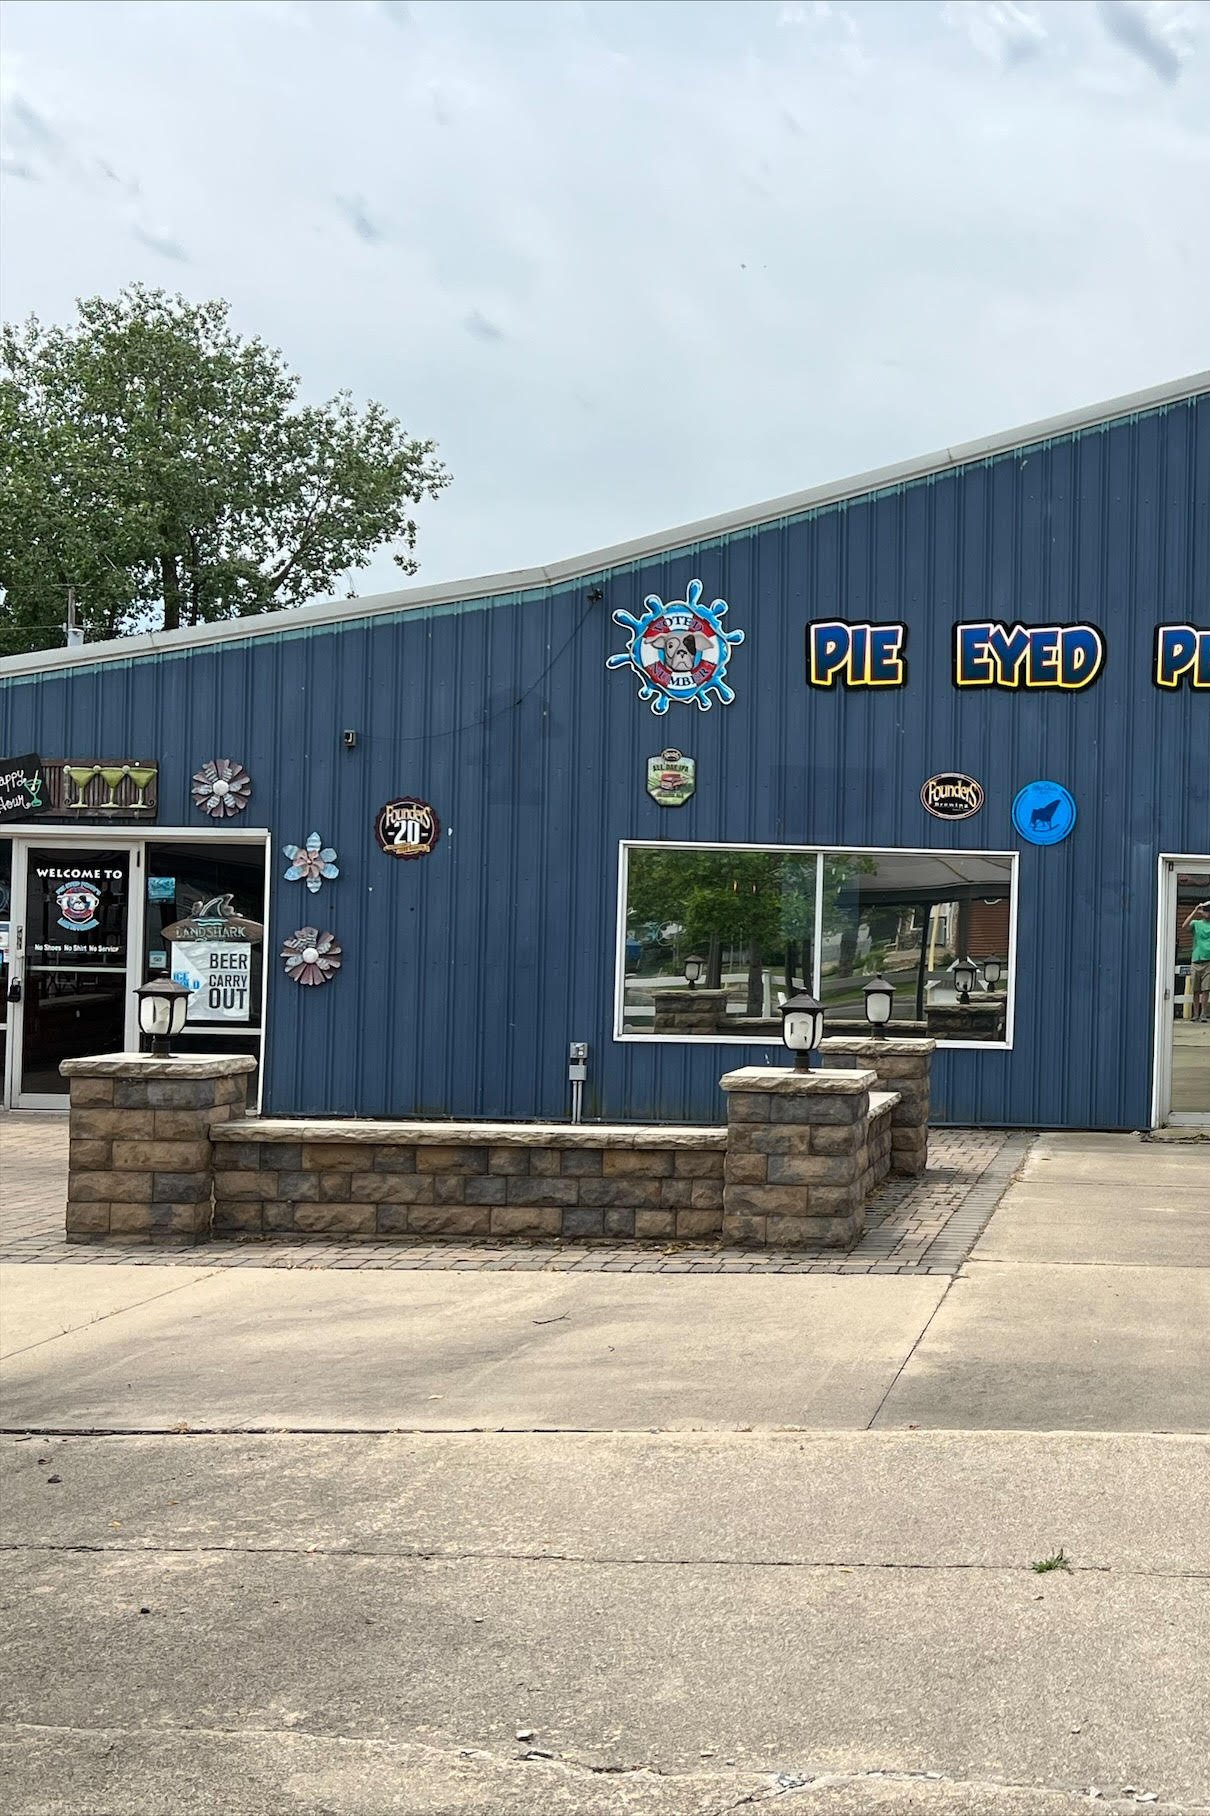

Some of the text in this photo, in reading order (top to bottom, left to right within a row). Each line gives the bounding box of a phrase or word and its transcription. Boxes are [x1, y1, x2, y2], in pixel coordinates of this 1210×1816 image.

[654, 616, 703, 632] VOTED
[810, 622, 903, 686] PIE
[957, 623, 1102, 689] EYED
[0, 770, 27, 792] appy
[928, 780, 979, 808] Founders
[385, 804, 432, 829] Founders
[393, 820, 420, 845] 20
[36, 868, 123, 879] WELCOME TO
[175, 926, 246, 939] LANDSHARK
[209, 953, 248, 969] BEER
[209, 974, 248, 987] CARRY
[208, 989, 248, 1010] OUT
